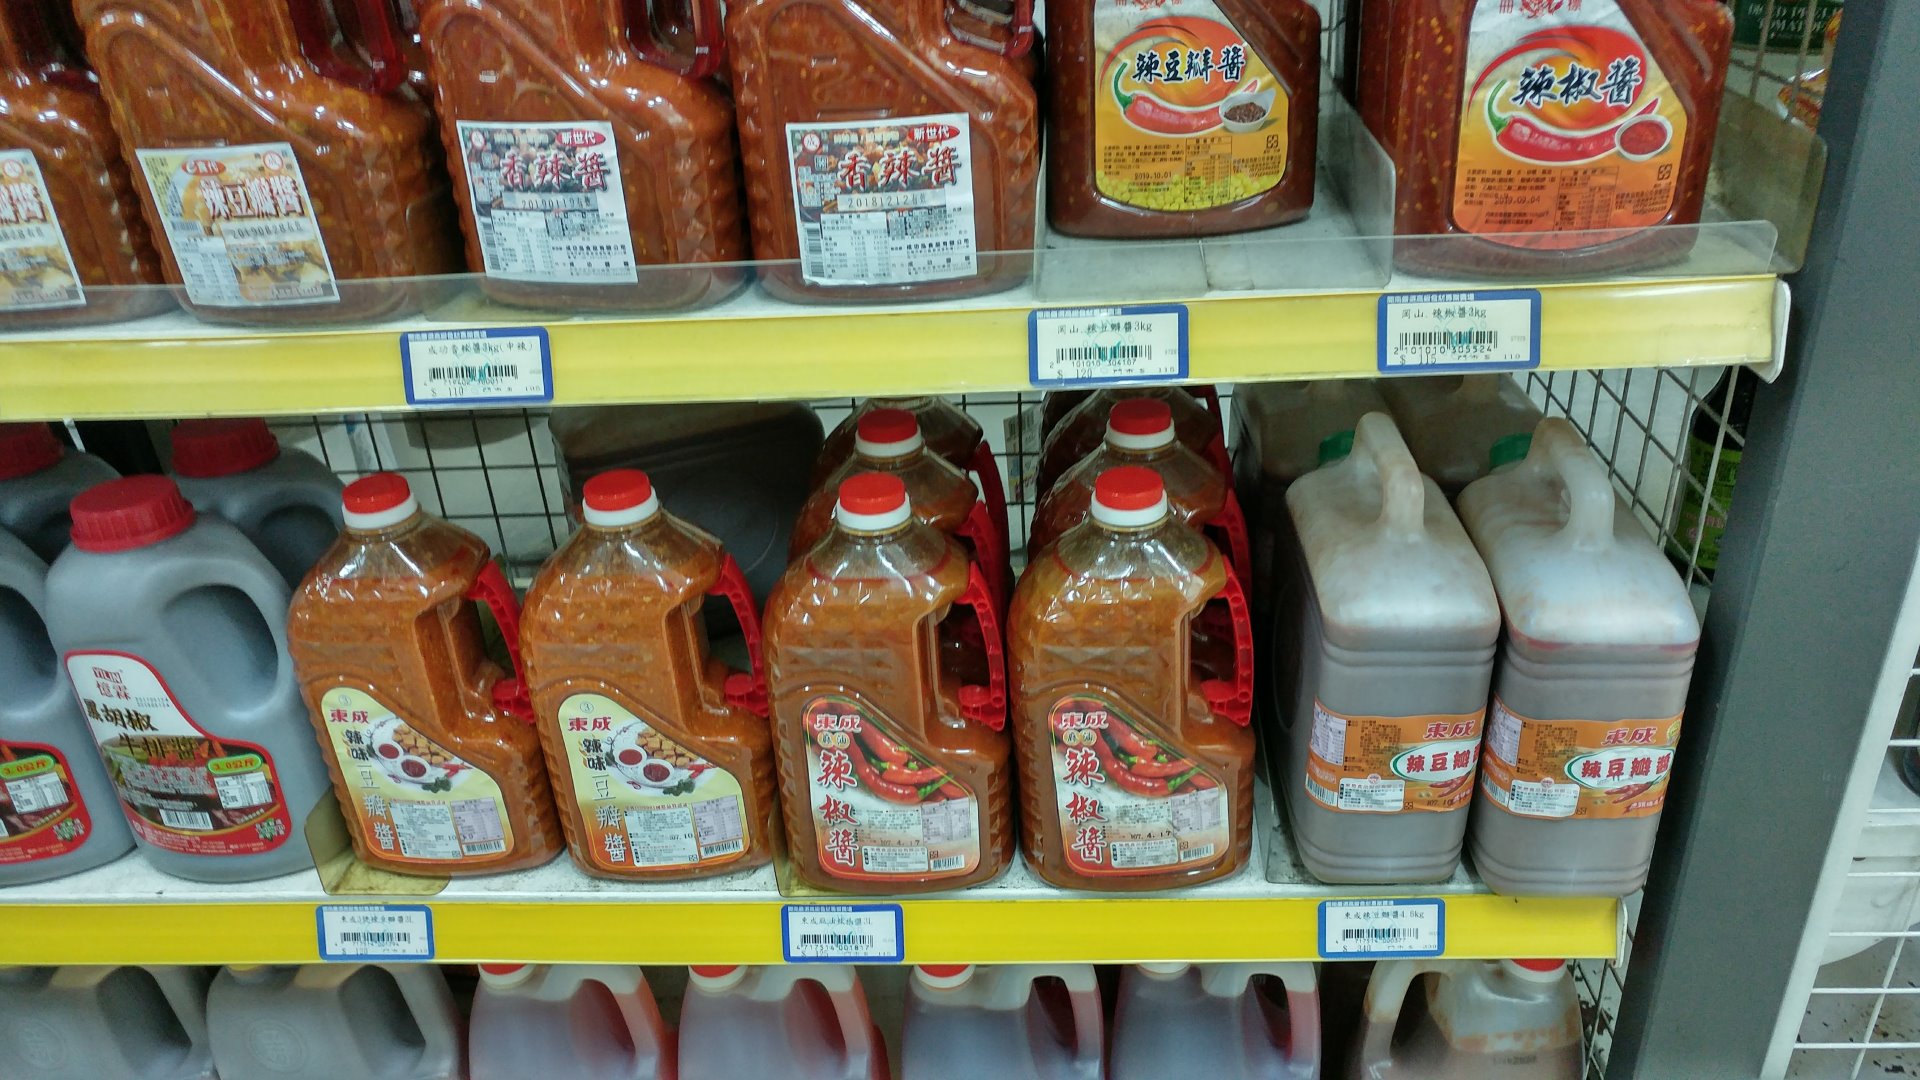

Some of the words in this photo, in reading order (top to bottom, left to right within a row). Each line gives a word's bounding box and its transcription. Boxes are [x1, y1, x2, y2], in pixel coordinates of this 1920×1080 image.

[1132, 44, 1247, 84] 辣豆瓣醬
[1509, 54, 1644, 107] 辣椒醬
[561, 131, 596, 146] 新世代
[914, 126, 950, 142] 新世代
[500, 150, 611, 192] 香辣醬
[838, 144, 962, 190] 香辣醬
[93, 666, 123, 685] YILIN
[83, 698, 159, 732] 黑胡椒
[329, 709, 370, 725] 東成
[568, 717, 612, 733] 東成
[813, 714, 863, 733] 東成
[1059, 711, 1110, 730] 東成
[1422, 720, 1476, 740] 東成
[1600, 727, 1658, 746] 東成
[119, 733, 199, 760] 牛排醬
[816, 748, 864, 866] 辣椒醬
[1063, 747, 1109, 865] 辣椒醬
